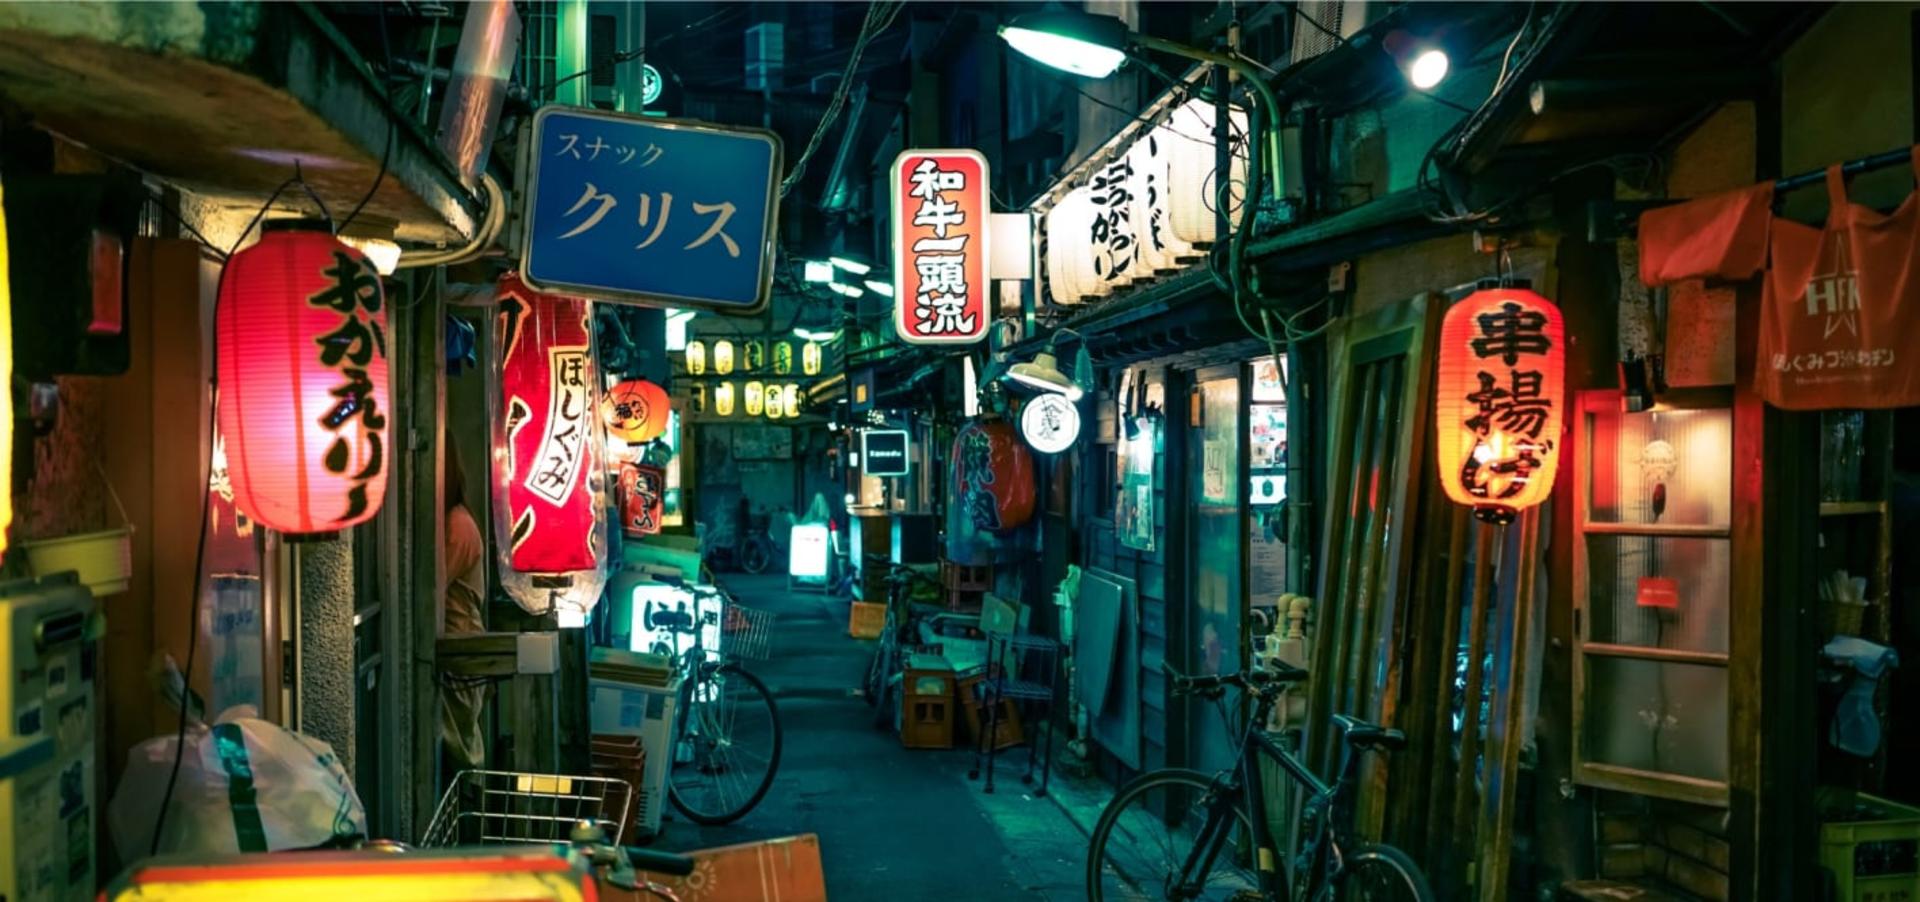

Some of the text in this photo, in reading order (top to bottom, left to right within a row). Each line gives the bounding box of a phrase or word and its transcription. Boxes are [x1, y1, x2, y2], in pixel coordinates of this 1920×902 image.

[555, 134, 664, 168] スナック
[556, 181, 741, 259] クリス
[909, 157, 977, 335] 和牛一頭流
[538, 356, 584, 488] ほしぐみ
[1464, 302, 1553, 499] 串揚げ
